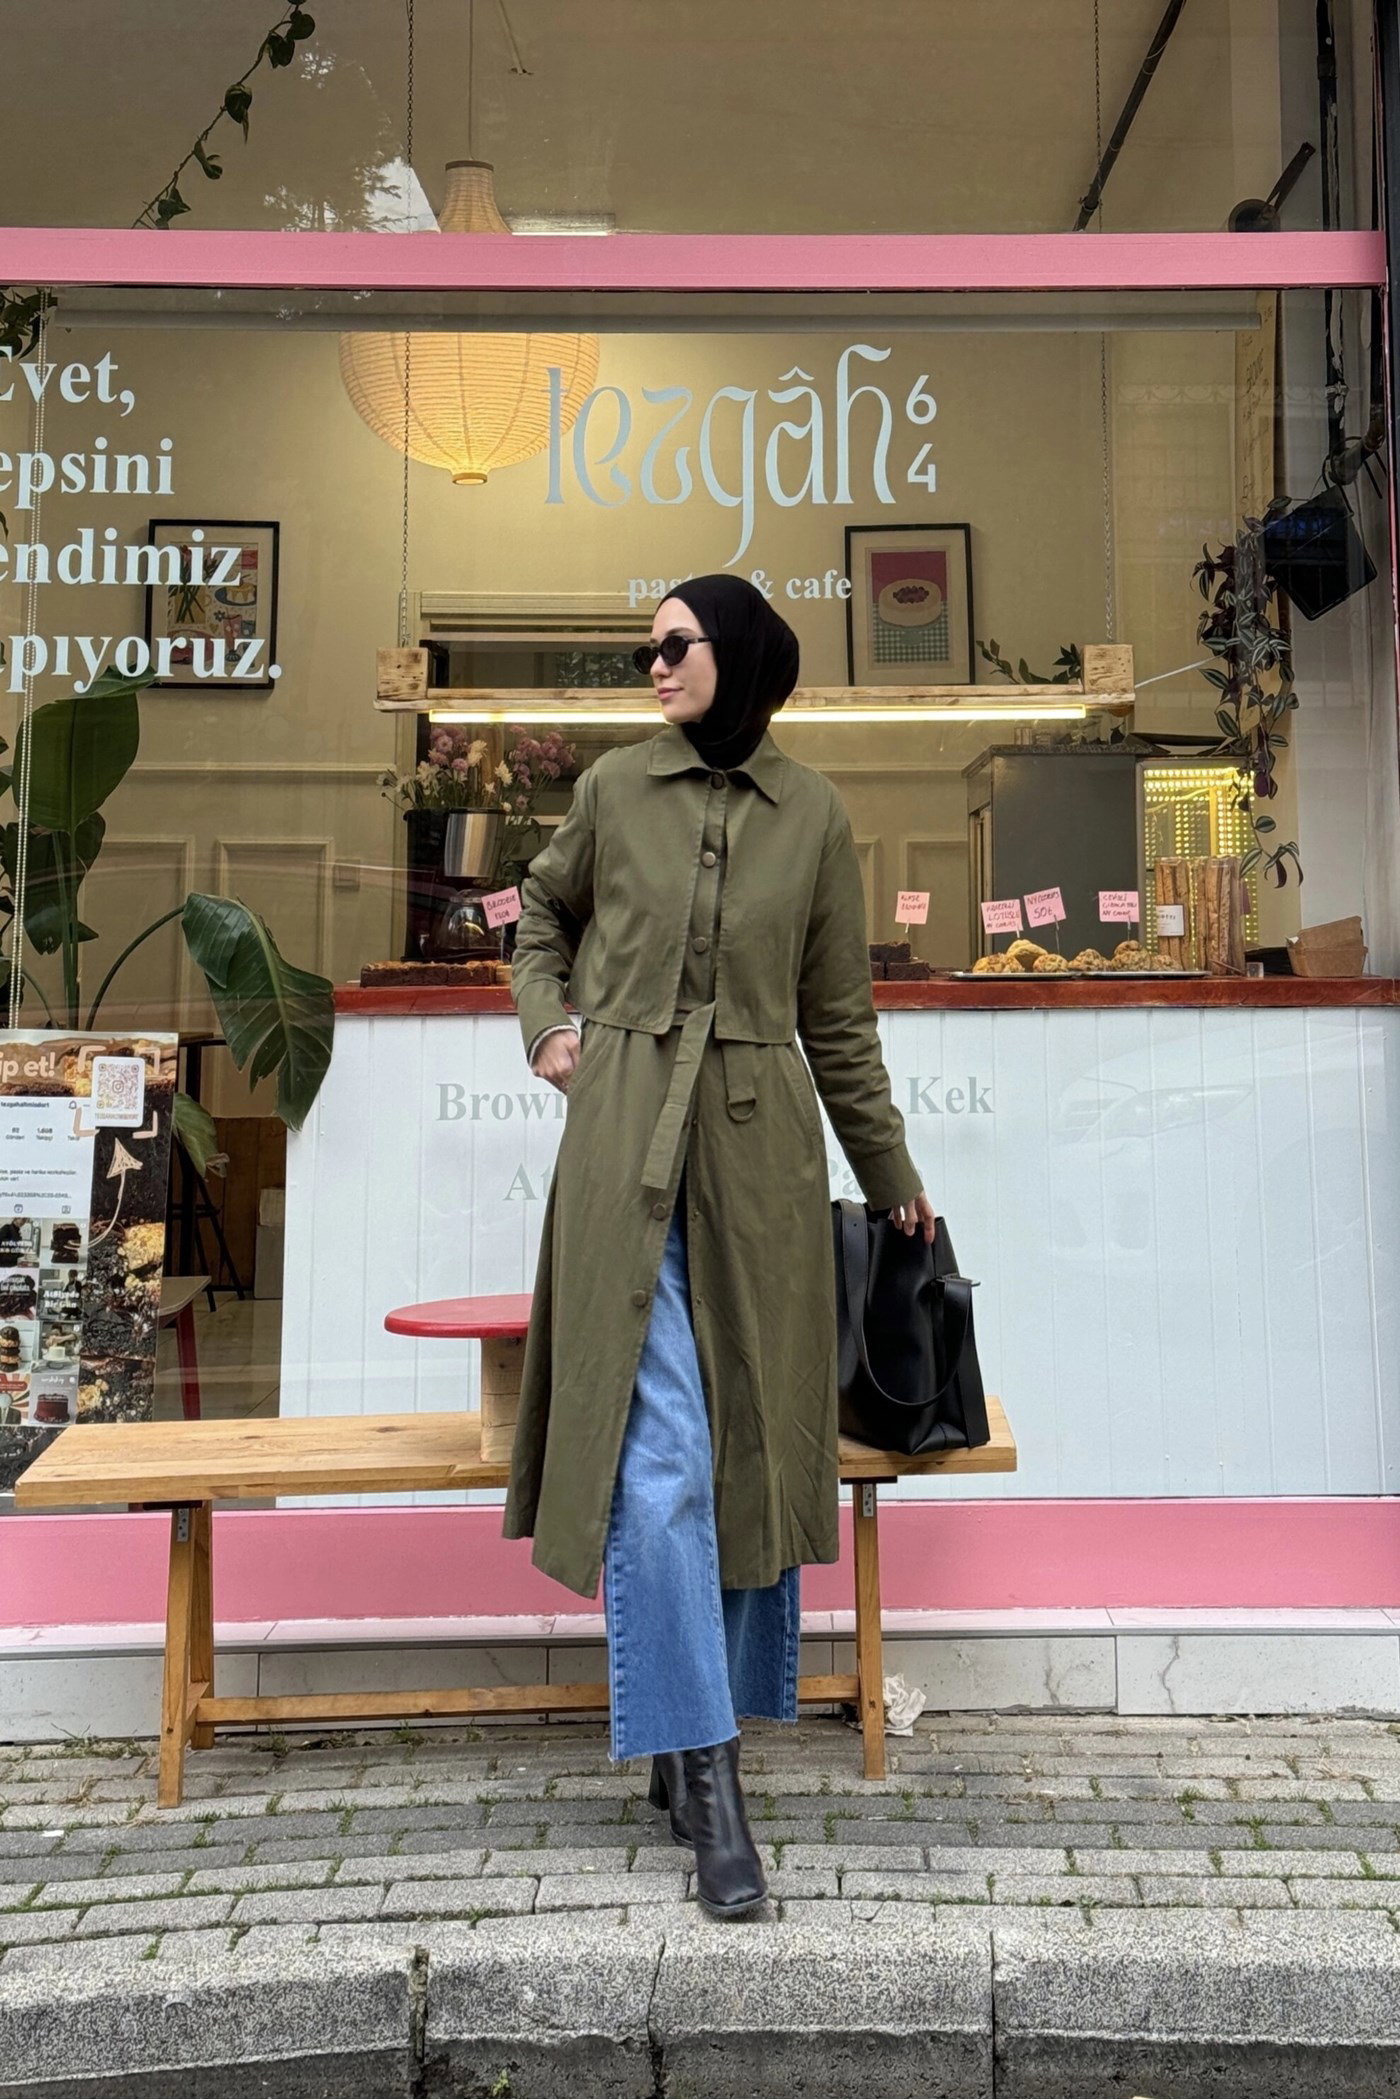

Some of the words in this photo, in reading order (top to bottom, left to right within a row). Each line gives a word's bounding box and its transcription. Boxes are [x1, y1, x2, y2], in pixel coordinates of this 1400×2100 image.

[0, 346, 135, 417] vet,
[906, 375, 937, 424] 6
[907, 443, 936, 492] 4
[0, 527, 241, 586] ndimiz
[751, 570, 773, 599] &
[786, 569, 851, 599] cafe
[0, 634, 282, 693] pıyoruz.
[24, 1051, 55, 1077] et!
[906, 1076, 995, 1114] Kek
